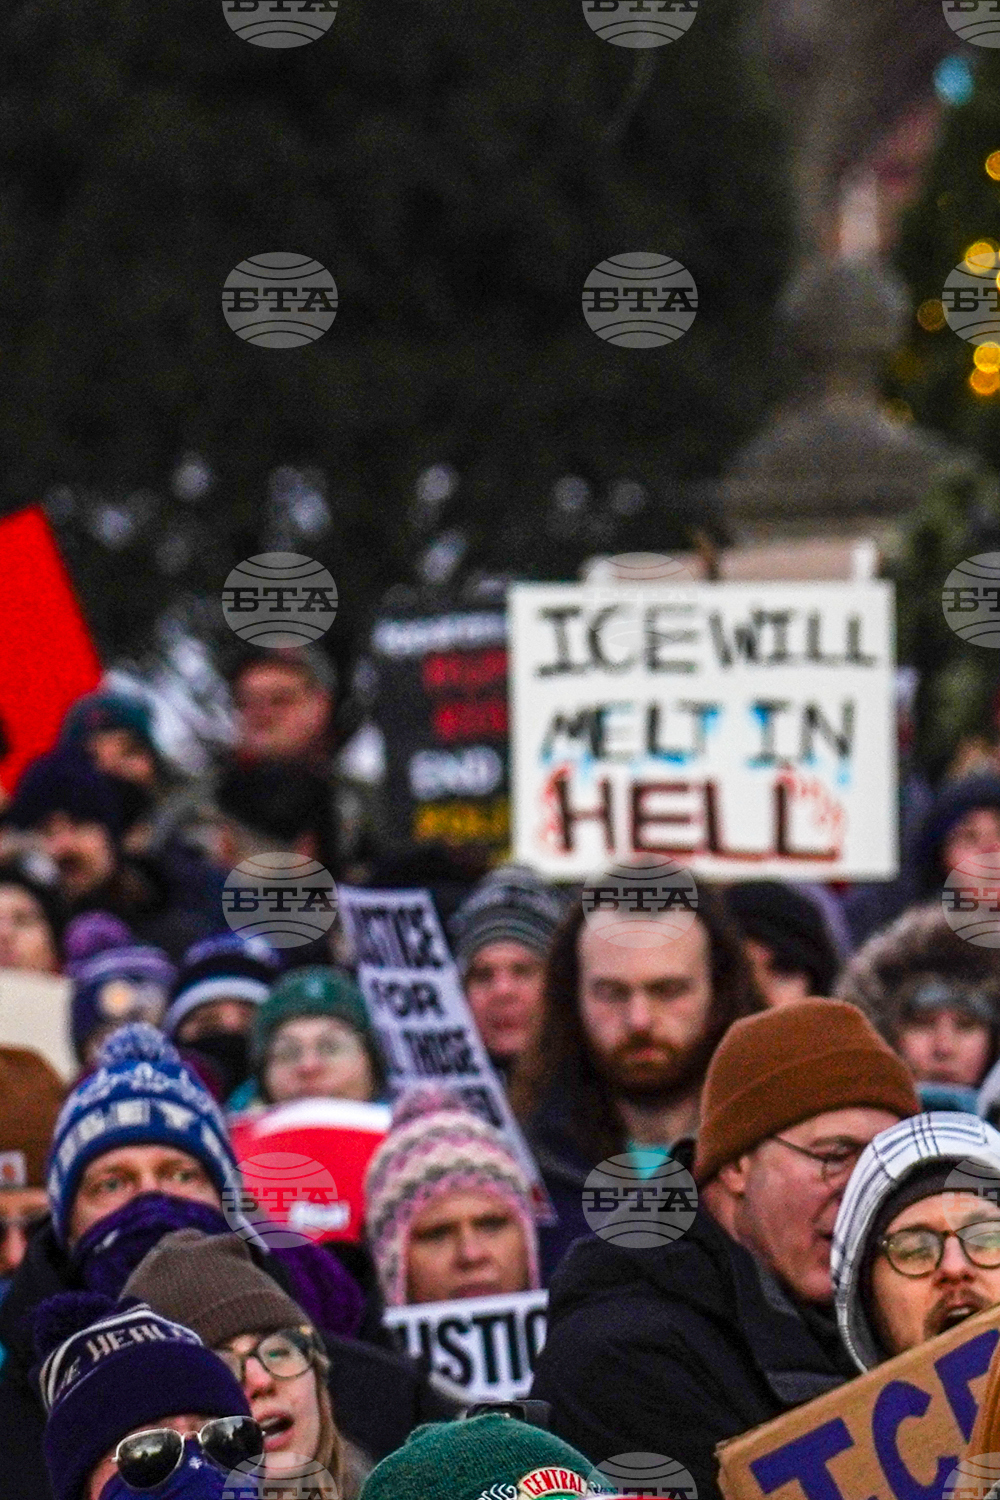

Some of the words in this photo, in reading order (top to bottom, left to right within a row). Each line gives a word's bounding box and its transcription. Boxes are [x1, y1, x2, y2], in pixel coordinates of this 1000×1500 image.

[535, 603, 699, 678] ICE
[706, 606, 877, 671] WILL
[541, 698, 720, 765] MELT
[747, 697, 856, 766] IN
[550, 768, 842, 862] HELL
[523, 1468, 584, 1497] CENTRAL
